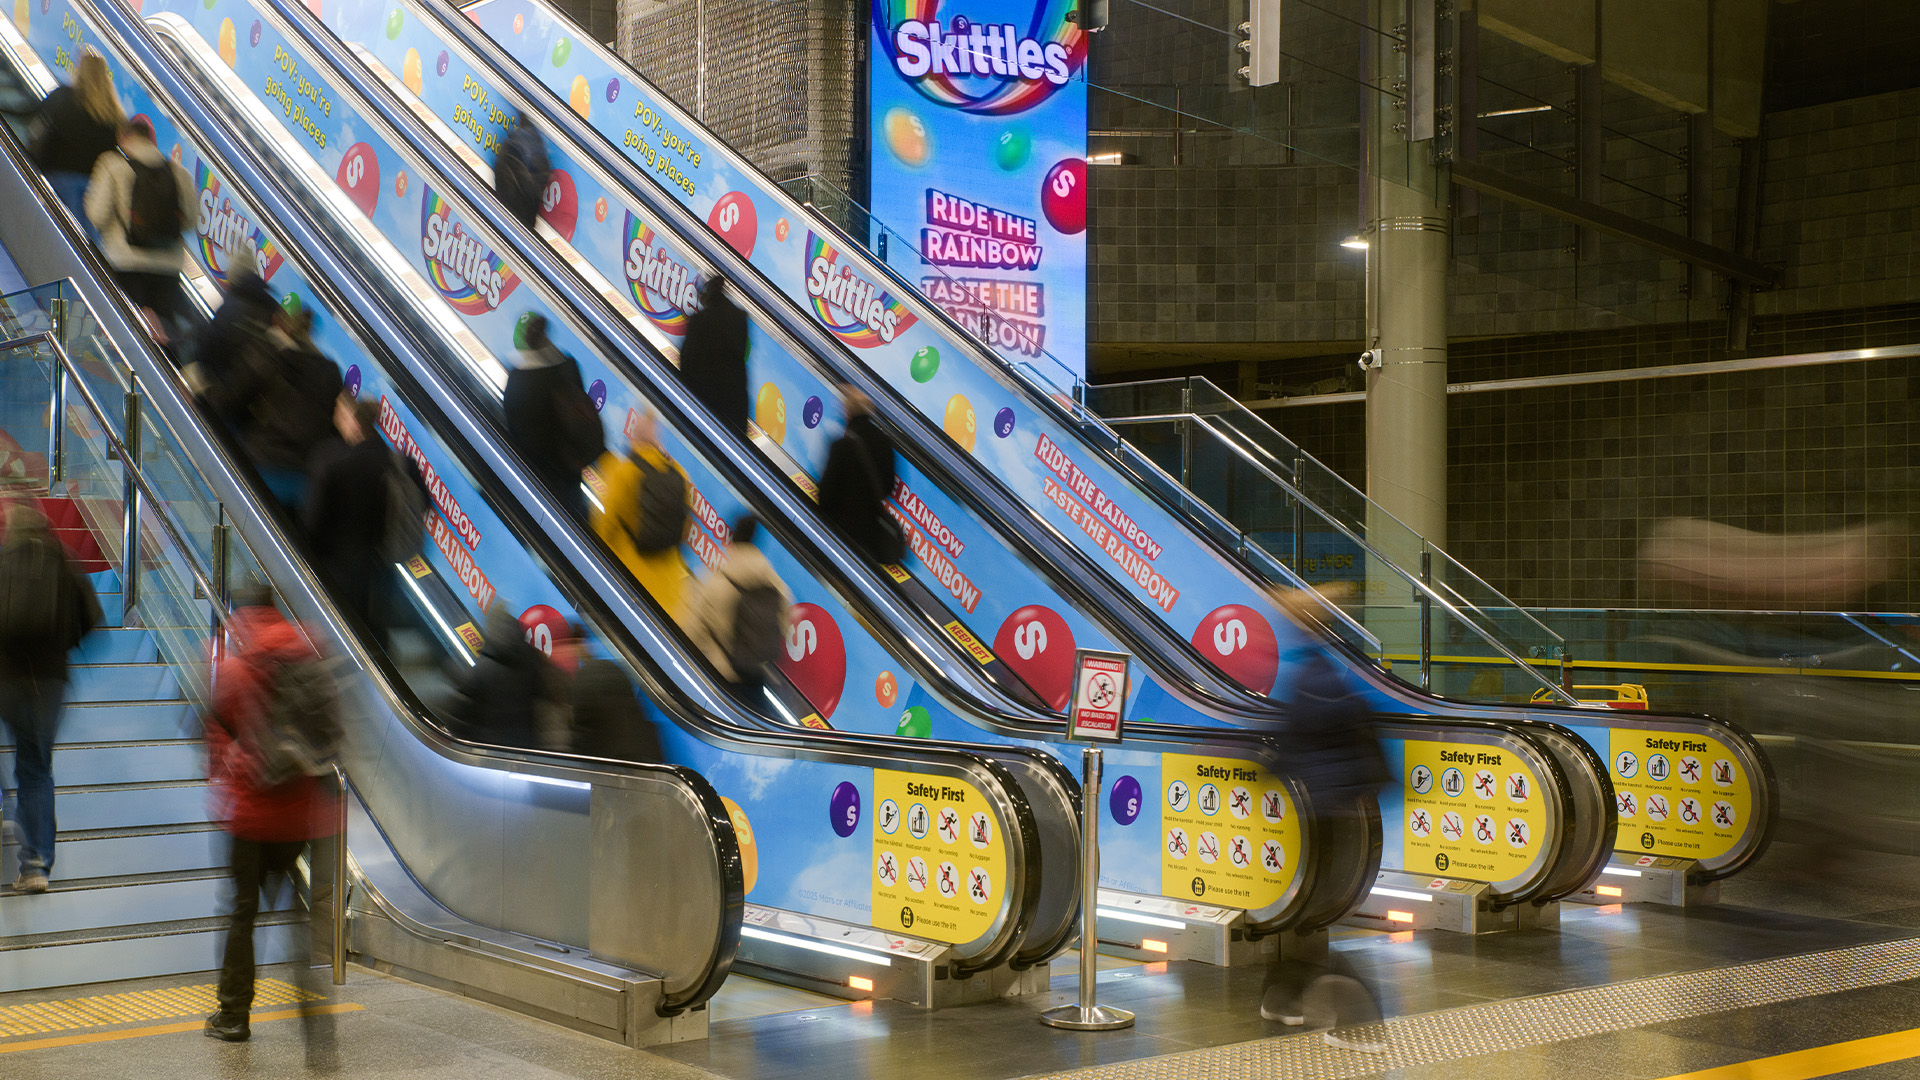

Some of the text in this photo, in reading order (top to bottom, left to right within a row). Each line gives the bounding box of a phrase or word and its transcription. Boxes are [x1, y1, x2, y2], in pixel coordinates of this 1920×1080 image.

[896, 15, 1069, 85] Skittles
[274, 44, 331, 116] POV: you're
[463, 74, 488, 111] POV:
[265, 76, 326, 148] going places
[453, 104, 483, 141] going
[634, 100, 701, 167] POV: you're
[466, 154, 479, 166] LEFT
[624, 129, 695, 196] going places
[932, 190, 1035, 239] RIDE THE
[423, 213, 501, 308] Skittles
[553, 239, 578, 263] KEEP LEFT
[927, 230, 1041, 265] RAINBOW
[626, 238, 700, 317] Skittle
[807, 257, 897, 342] Skittles
[921, 278, 1038, 314] TASTE THE
[380, 399, 406, 451] RIDE
[425, 473, 481, 549] RAINBOW
[794, 475, 814, 491] KEEP
[1037, 435, 1161, 559] RIDE THE RAINBOW
[899, 484, 964, 557] RAINBOW
[1044, 478, 1175, 609] TASTE THE RAINBOW
[409, 557, 426, 573] EFT
[433, 520, 492, 610] RAINBOW
[910, 530, 977, 610] RAINBOW
[461, 626, 482, 649] KEEP
[950, 625, 990, 661] KEEP LEFT
[1087, 659, 1120, 671] WARNING!
[1081, 710, 1090, 718] NO
[1081, 720, 1111, 729] ESCALATOR
[1440, 750, 1501, 766] Safety First
[1646, 738, 1706, 752] Safety First
[1197, 764, 1257, 782] Safety First
[907, 782, 964, 802] Safety First
[1269, 827, 1283, 835] luggage
[1452, 860, 1467, 868] Please
[819, 893, 834, 905] Mars
[836, 898, 842, 906] or
[1208, 885, 1223, 894] Please
[1233, 888, 1242, 896] the
[916, 915, 931, 925] Please
[940, 919, 949, 928] the
